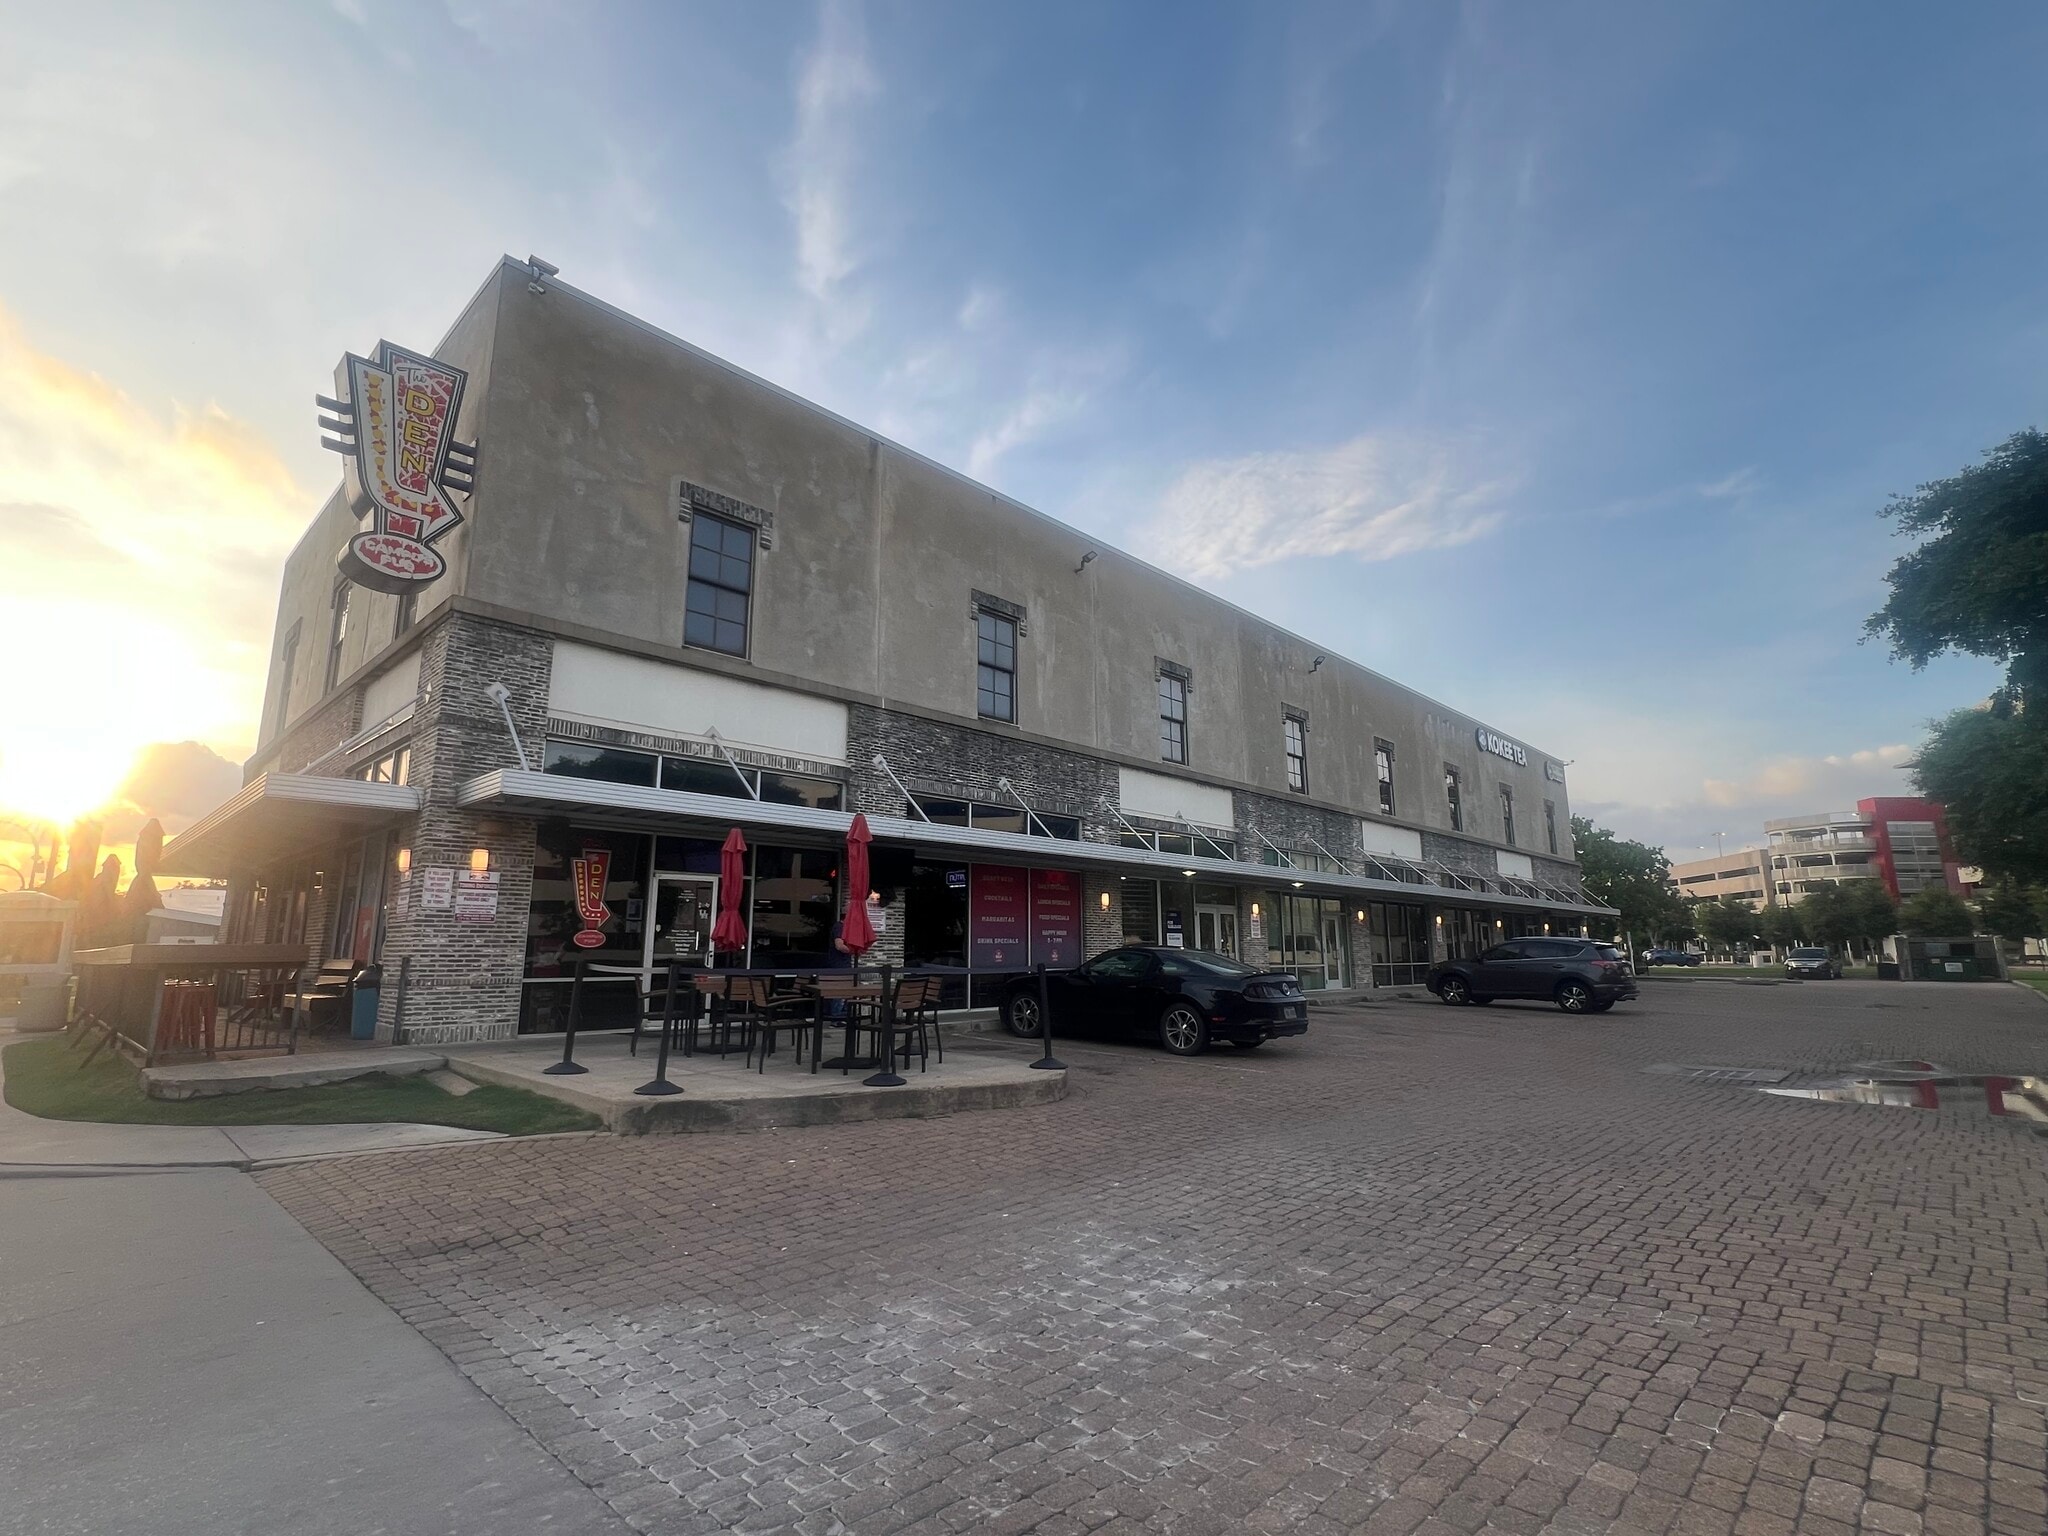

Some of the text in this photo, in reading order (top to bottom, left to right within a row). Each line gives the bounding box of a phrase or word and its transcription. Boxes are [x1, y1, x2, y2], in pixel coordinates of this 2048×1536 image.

[397, 366, 427, 385] The
[401, 388, 436, 474] DEN
[380, 554, 415, 573] PUB
[1487, 732, 1528, 767] KOKEE TEA
[591, 864, 602, 900] DEN
[977, 937, 1019, 945] DRINK SPECIALS
